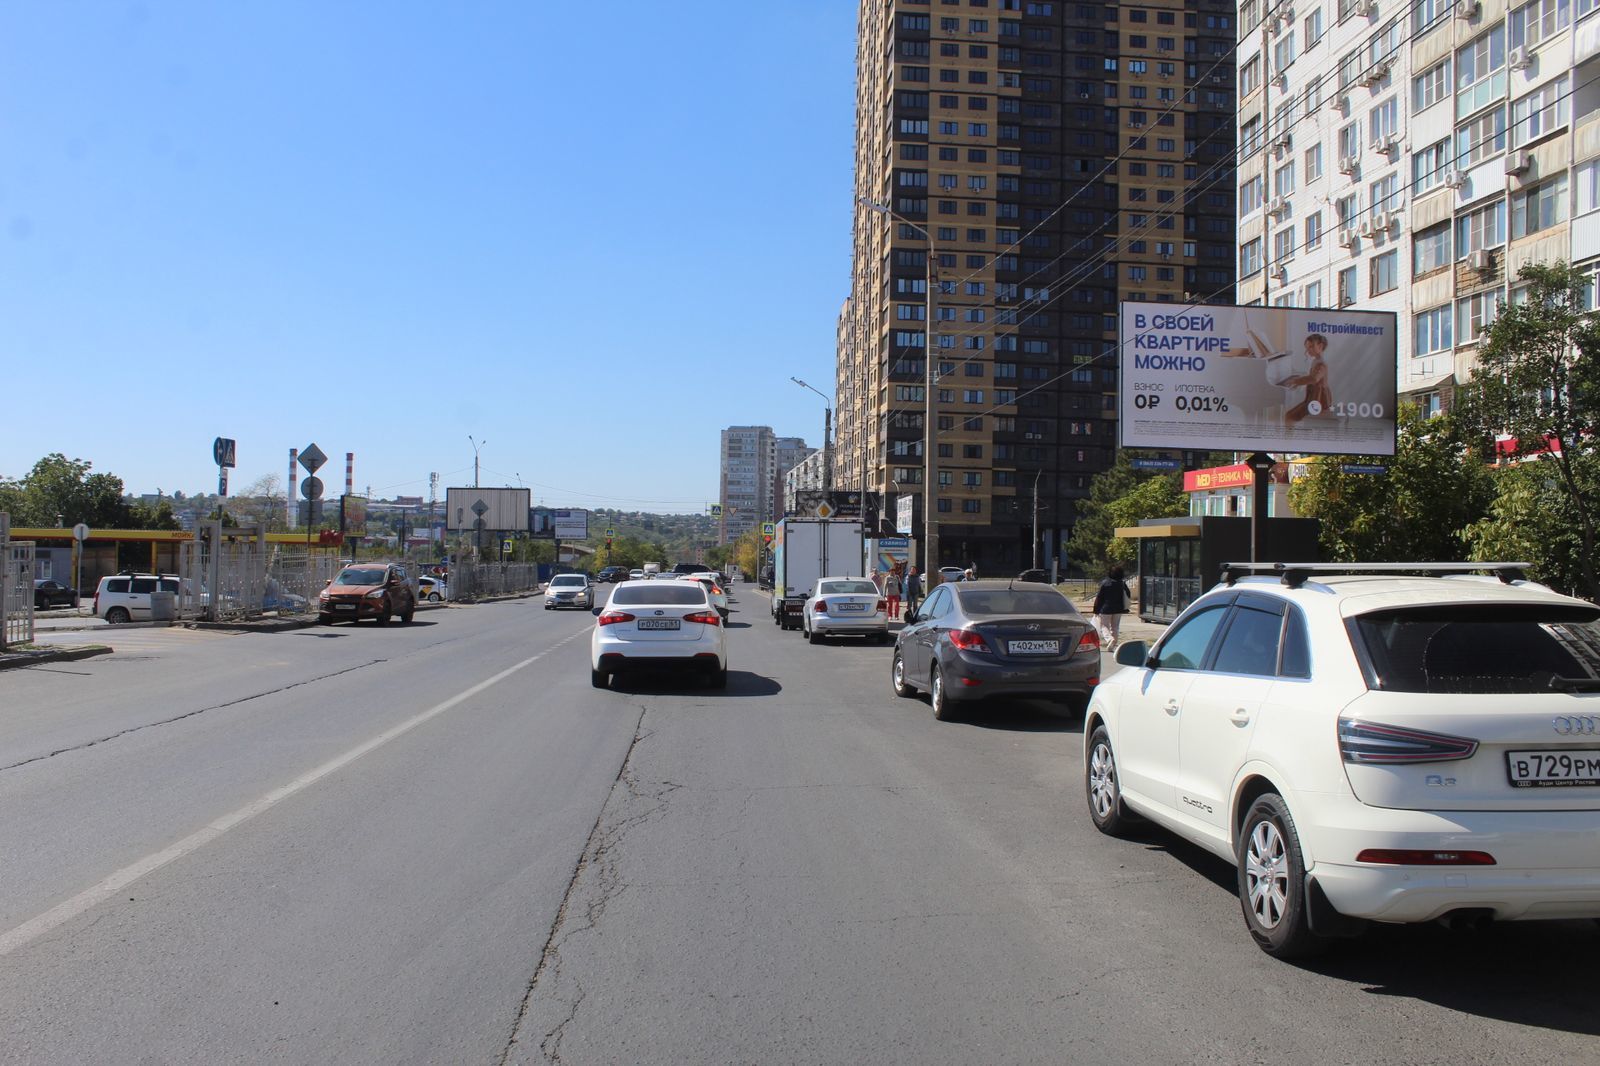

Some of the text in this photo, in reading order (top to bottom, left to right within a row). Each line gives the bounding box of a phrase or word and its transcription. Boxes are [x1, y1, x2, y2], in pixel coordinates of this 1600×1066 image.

[1135, 313, 1214, 331] В СВОЕЙ
[1307, 322, 1385, 335] ЮгСтройИнвест
[1135, 334, 1231, 352] КВАРТИРЕ
[1135, 354, 1206, 371] МОЖНО
[1134, 382, 1165, 392] ВЗНОС
[1174, 384, 1216, 393] ИПОТЕКА
[1175, 395, 1229, 413] 0,01%
[1182, 796, 1213, 814] quattro
